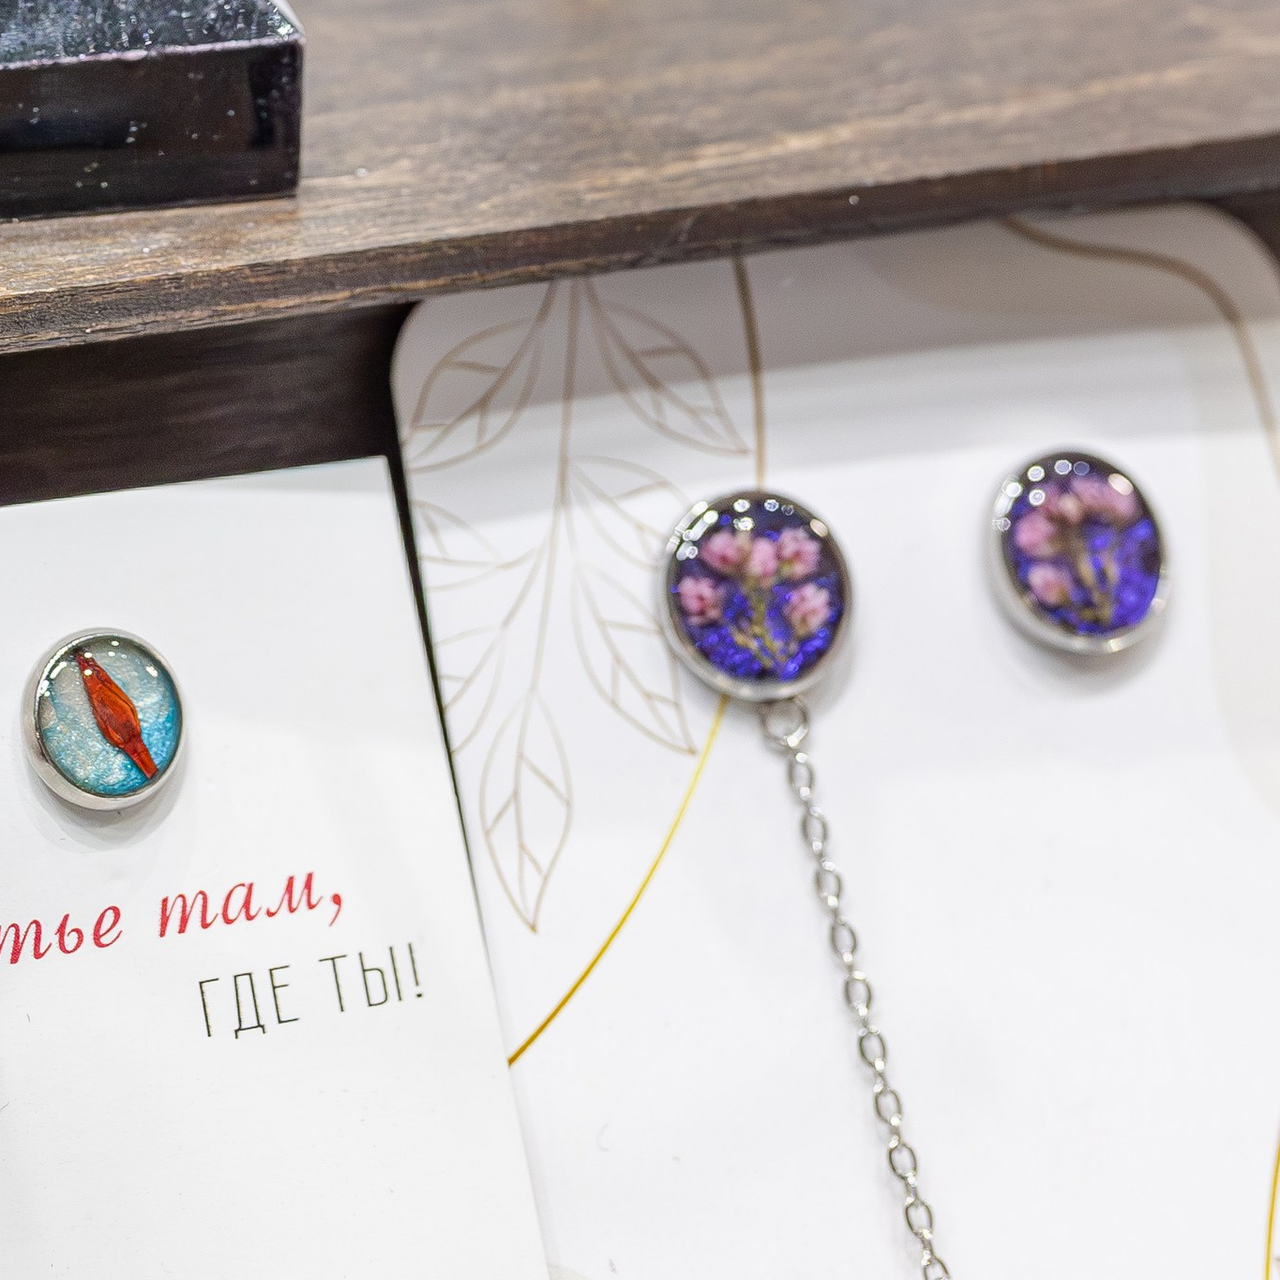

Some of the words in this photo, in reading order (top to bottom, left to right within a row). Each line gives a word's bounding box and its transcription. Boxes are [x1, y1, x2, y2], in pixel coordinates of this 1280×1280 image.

[157, 870, 344, 939] там,
[198, 964, 301, 1040] ГДЕ
[319, 942, 426, 1013] ТЫ!
